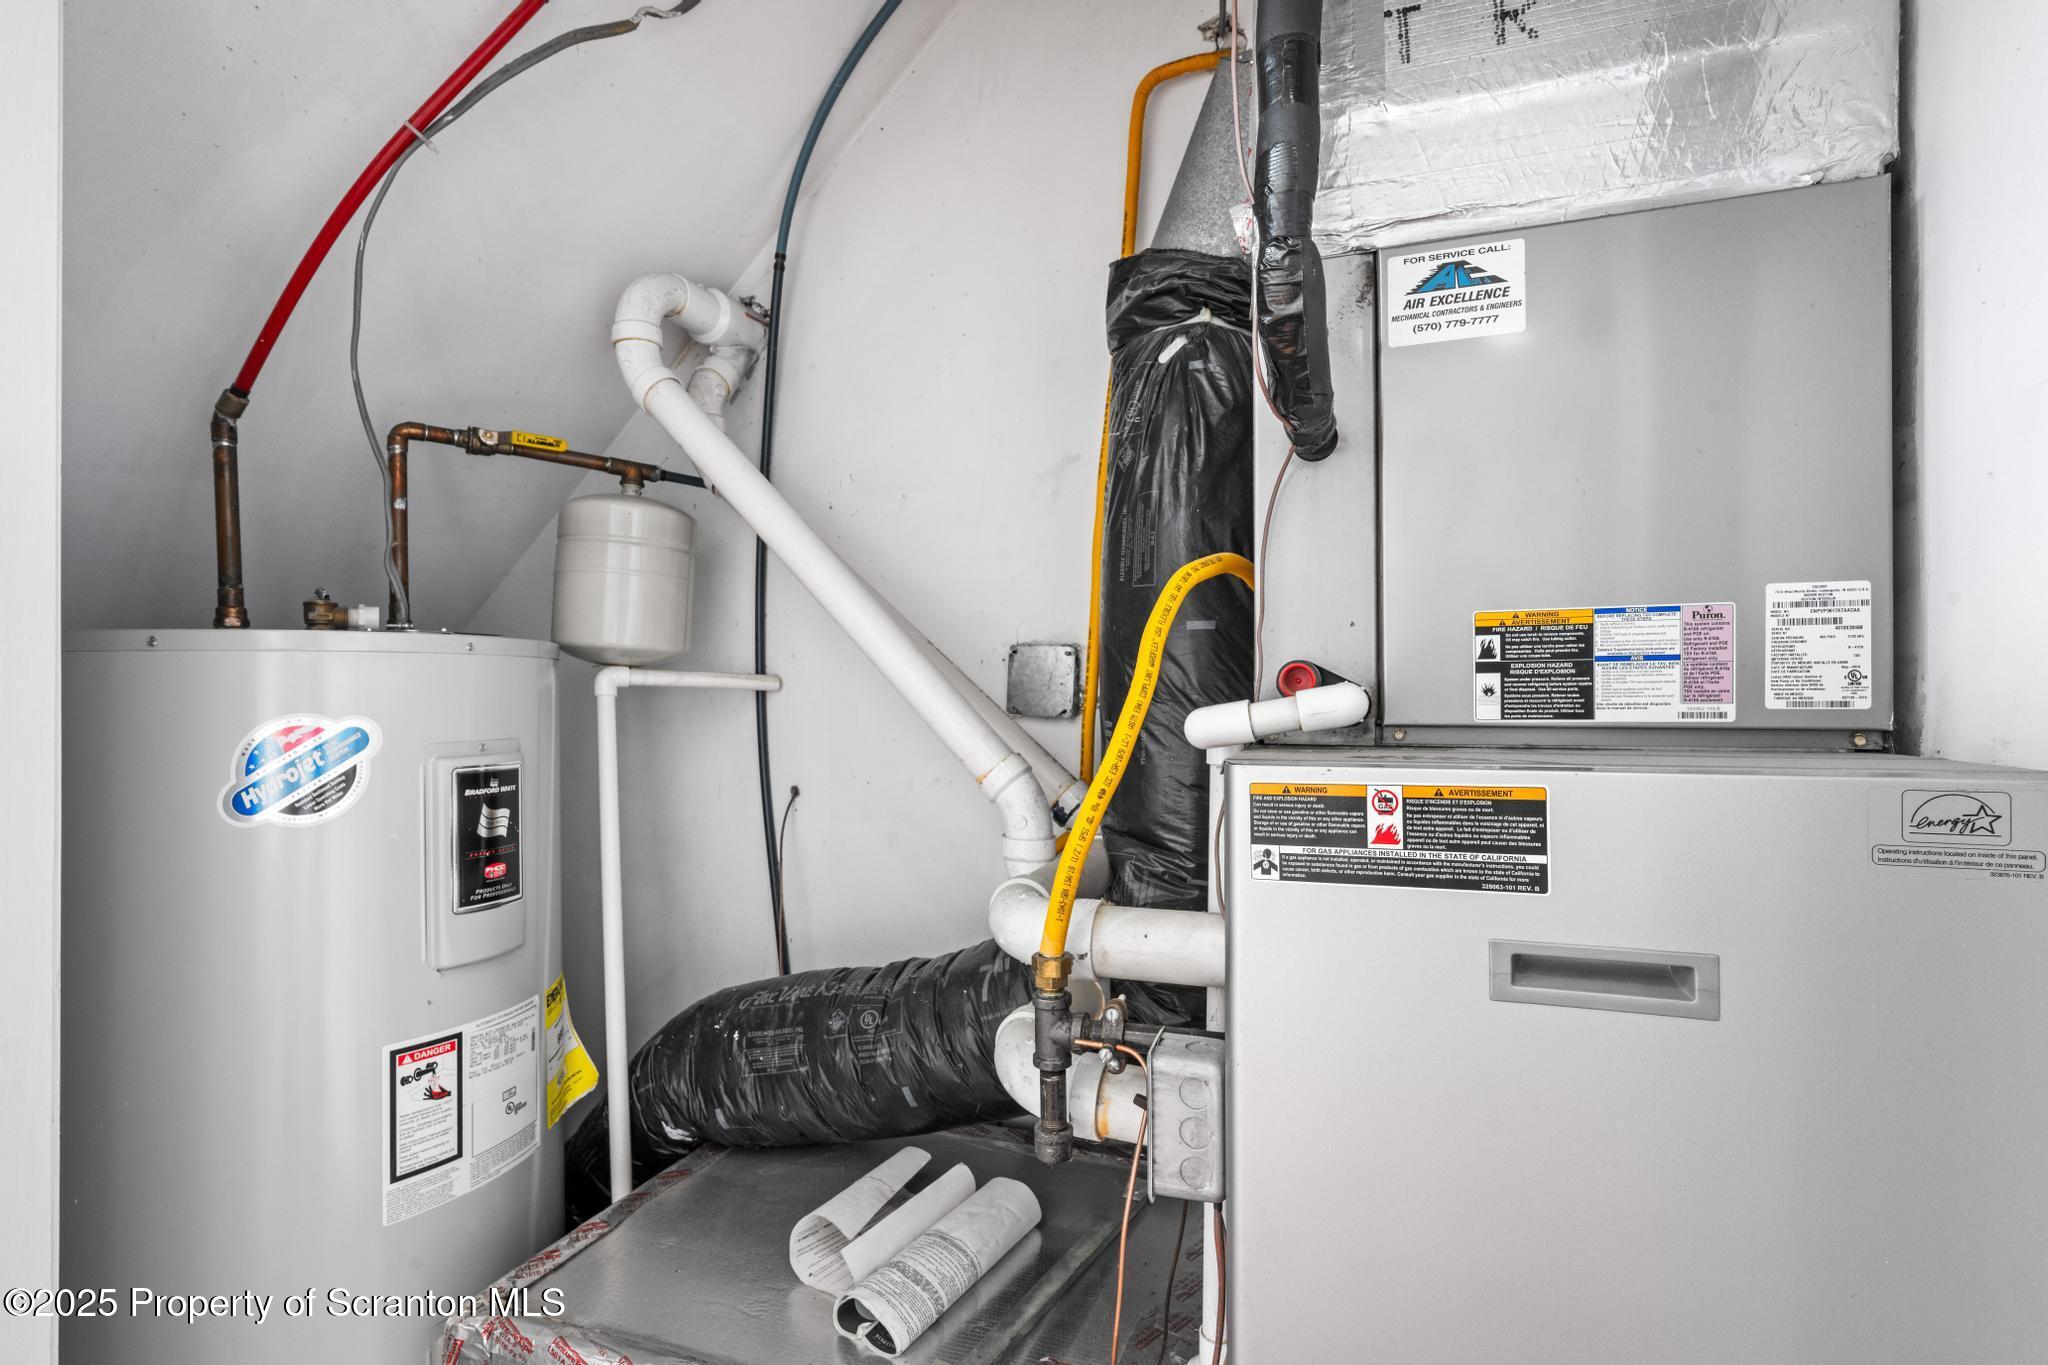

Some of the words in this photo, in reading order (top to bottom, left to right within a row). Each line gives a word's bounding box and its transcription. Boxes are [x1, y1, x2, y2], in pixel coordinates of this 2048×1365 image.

[1404, 256, 1426, 265] FOR
[1428, 249, 1475, 262] SERVICE
[1478, 244, 1511, 255] CALL:
[1403, 298, 1425, 311] AIR
[1429, 286, 1511, 307] EXCELLENCE
[1391, 311, 1430, 323] MECHANICAL
[1432, 305, 1478, 318] CONTRACTORS
[1486, 299, 1523, 310] ENGINEERS
[1413, 321, 1442, 334] (570)
[1446, 315, 1499, 329] 779-7777
[1511, 618, 1570, 626] AVERTISSEMENT
[1525, 611, 1560, 619] WARNING
[464, 787, 500, 796] BRADFORD
[501, 784, 516, 793] WHITE
[1449, 789, 1514, 798] AVERTISSEMENT
[1916, 816, 1970, 835] energy
[1333, 849, 1378, 857] APPLIANCES
[1481, 855, 1528, 863] CALIFORNIA
[414, 1044, 451, 1060] DANGER
